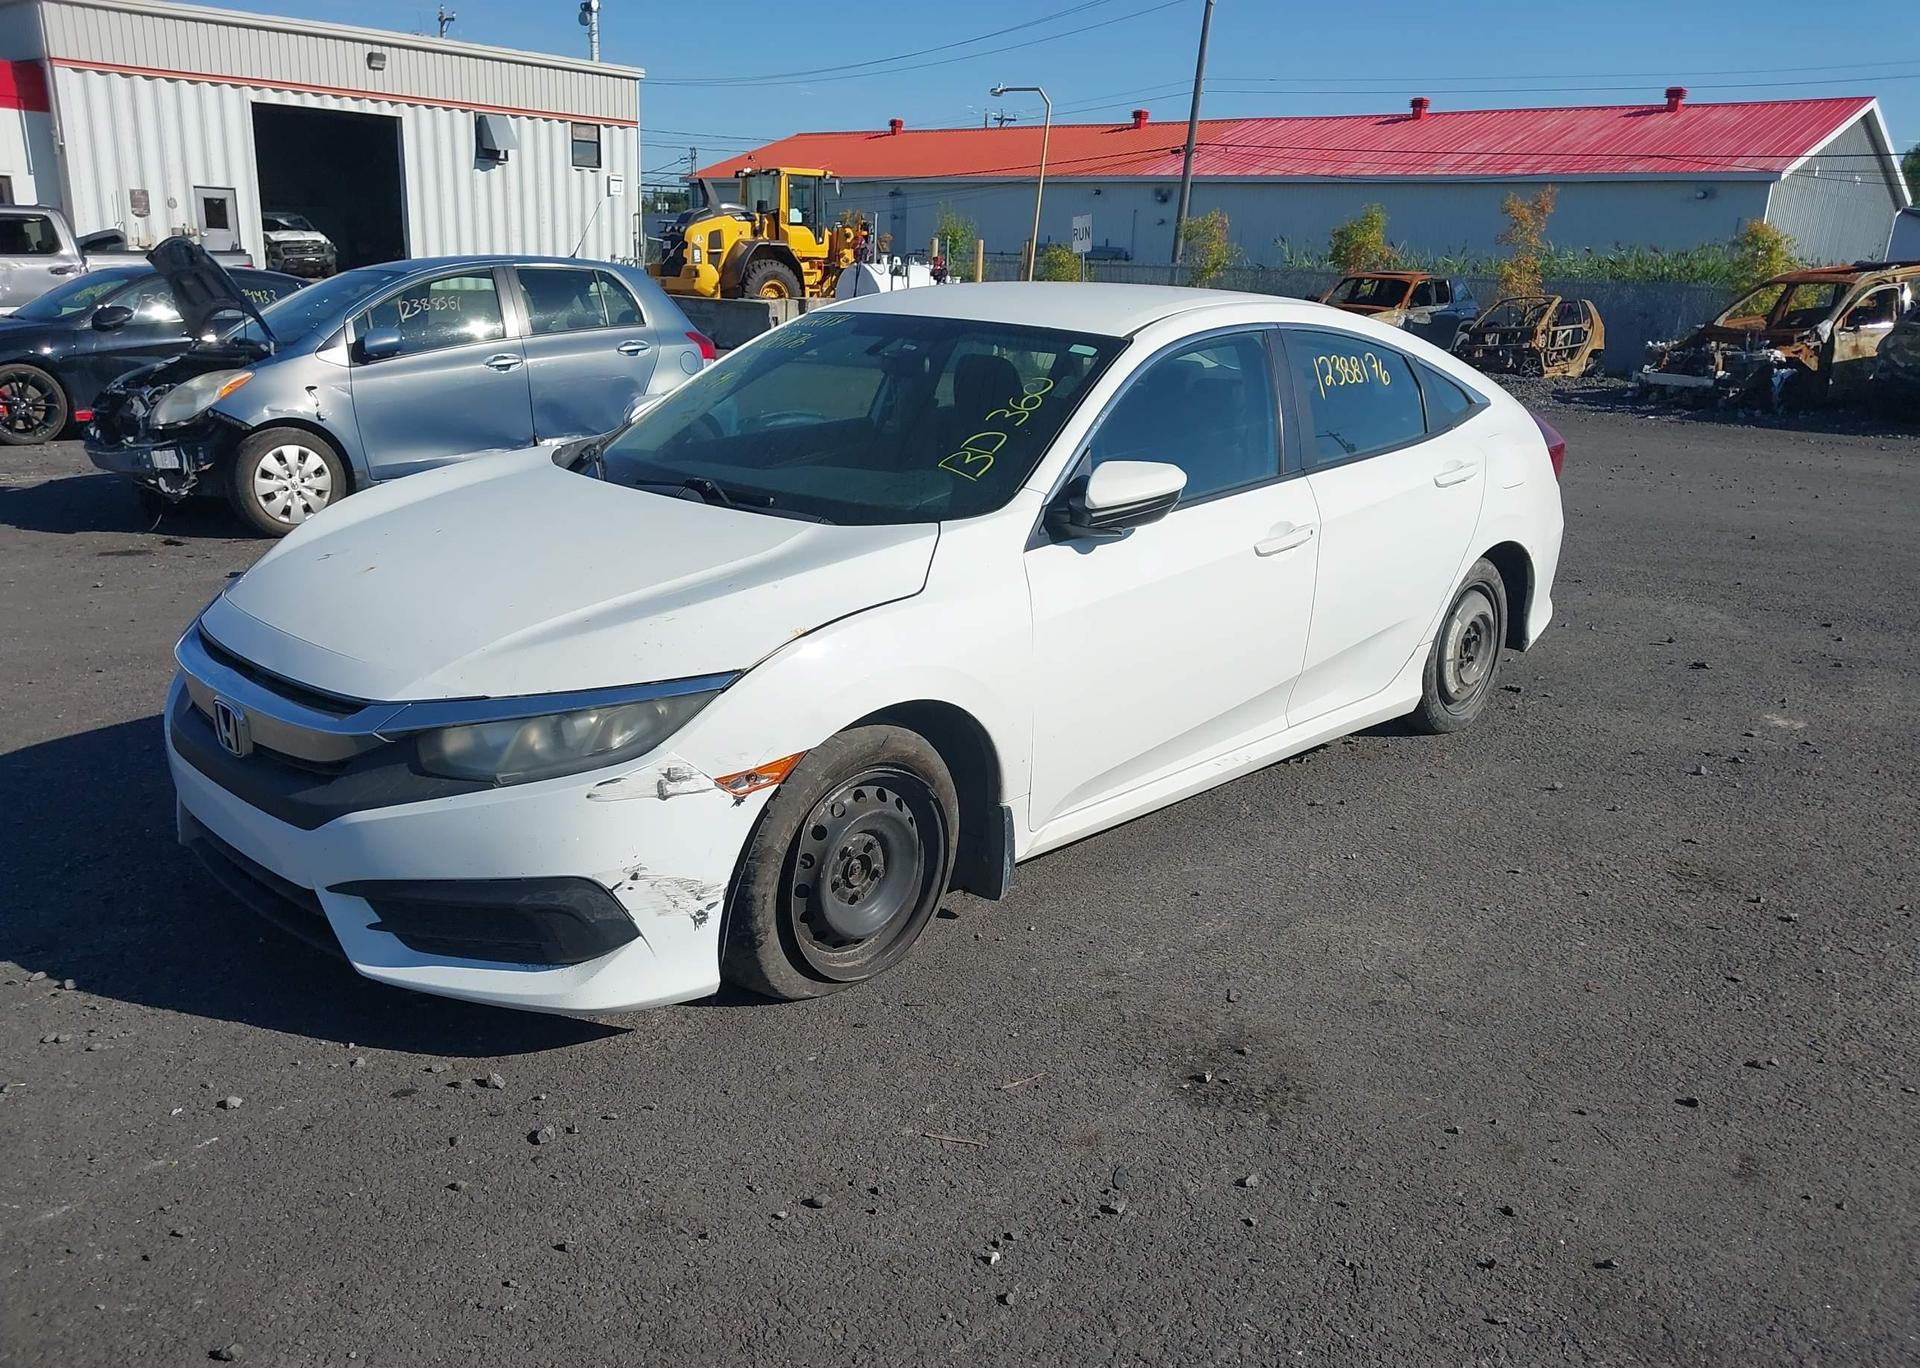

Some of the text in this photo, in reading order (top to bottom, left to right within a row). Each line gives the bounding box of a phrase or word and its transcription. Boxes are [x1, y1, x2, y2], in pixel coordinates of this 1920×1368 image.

[1073, 226, 1091, 241] RUN
[397, 295, 462, 323] 12388561
[1312, 352, 1391, 400] 12388176
[938, 377, 1056, 482] BD 360
